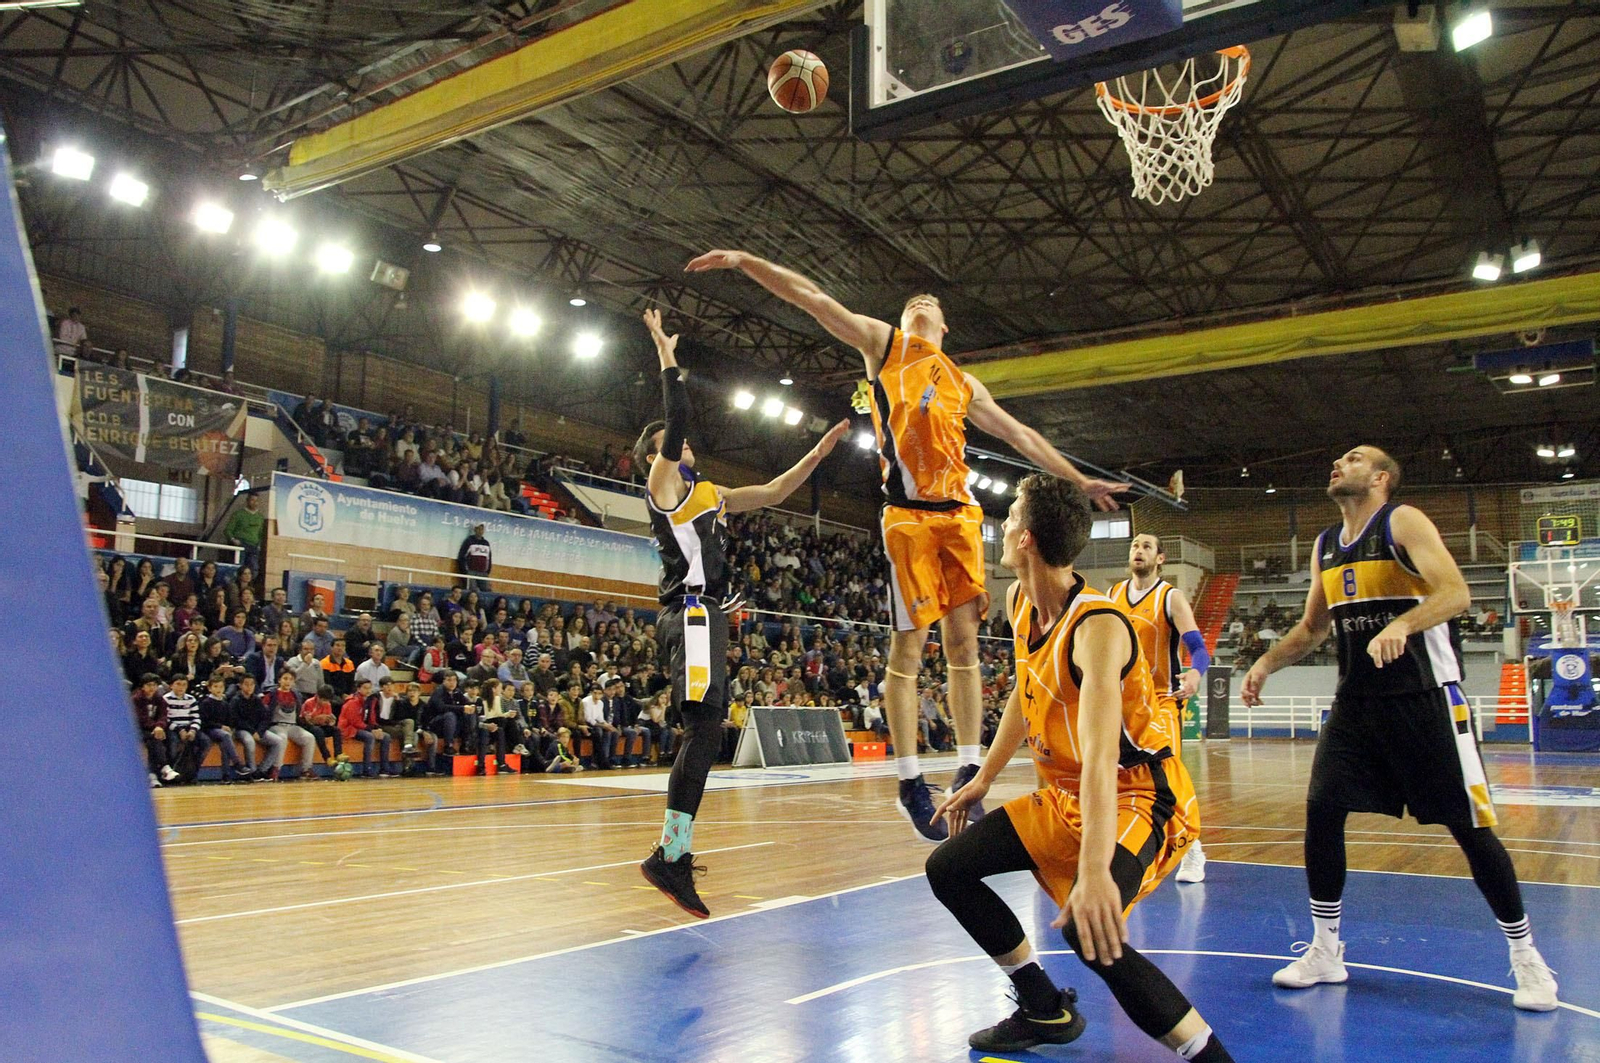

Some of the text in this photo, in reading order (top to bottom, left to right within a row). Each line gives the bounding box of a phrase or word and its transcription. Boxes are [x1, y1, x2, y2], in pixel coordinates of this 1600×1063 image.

[1050, 2, 1132, 45] GES
[167, 412, 195, 428] CON
[336, 492, 418, 515] Ayuntamiento
[359, 509, 375, 521] de
[377, 511, 417, 527] Huelva
[1343, 568, 1357, 597] 8
